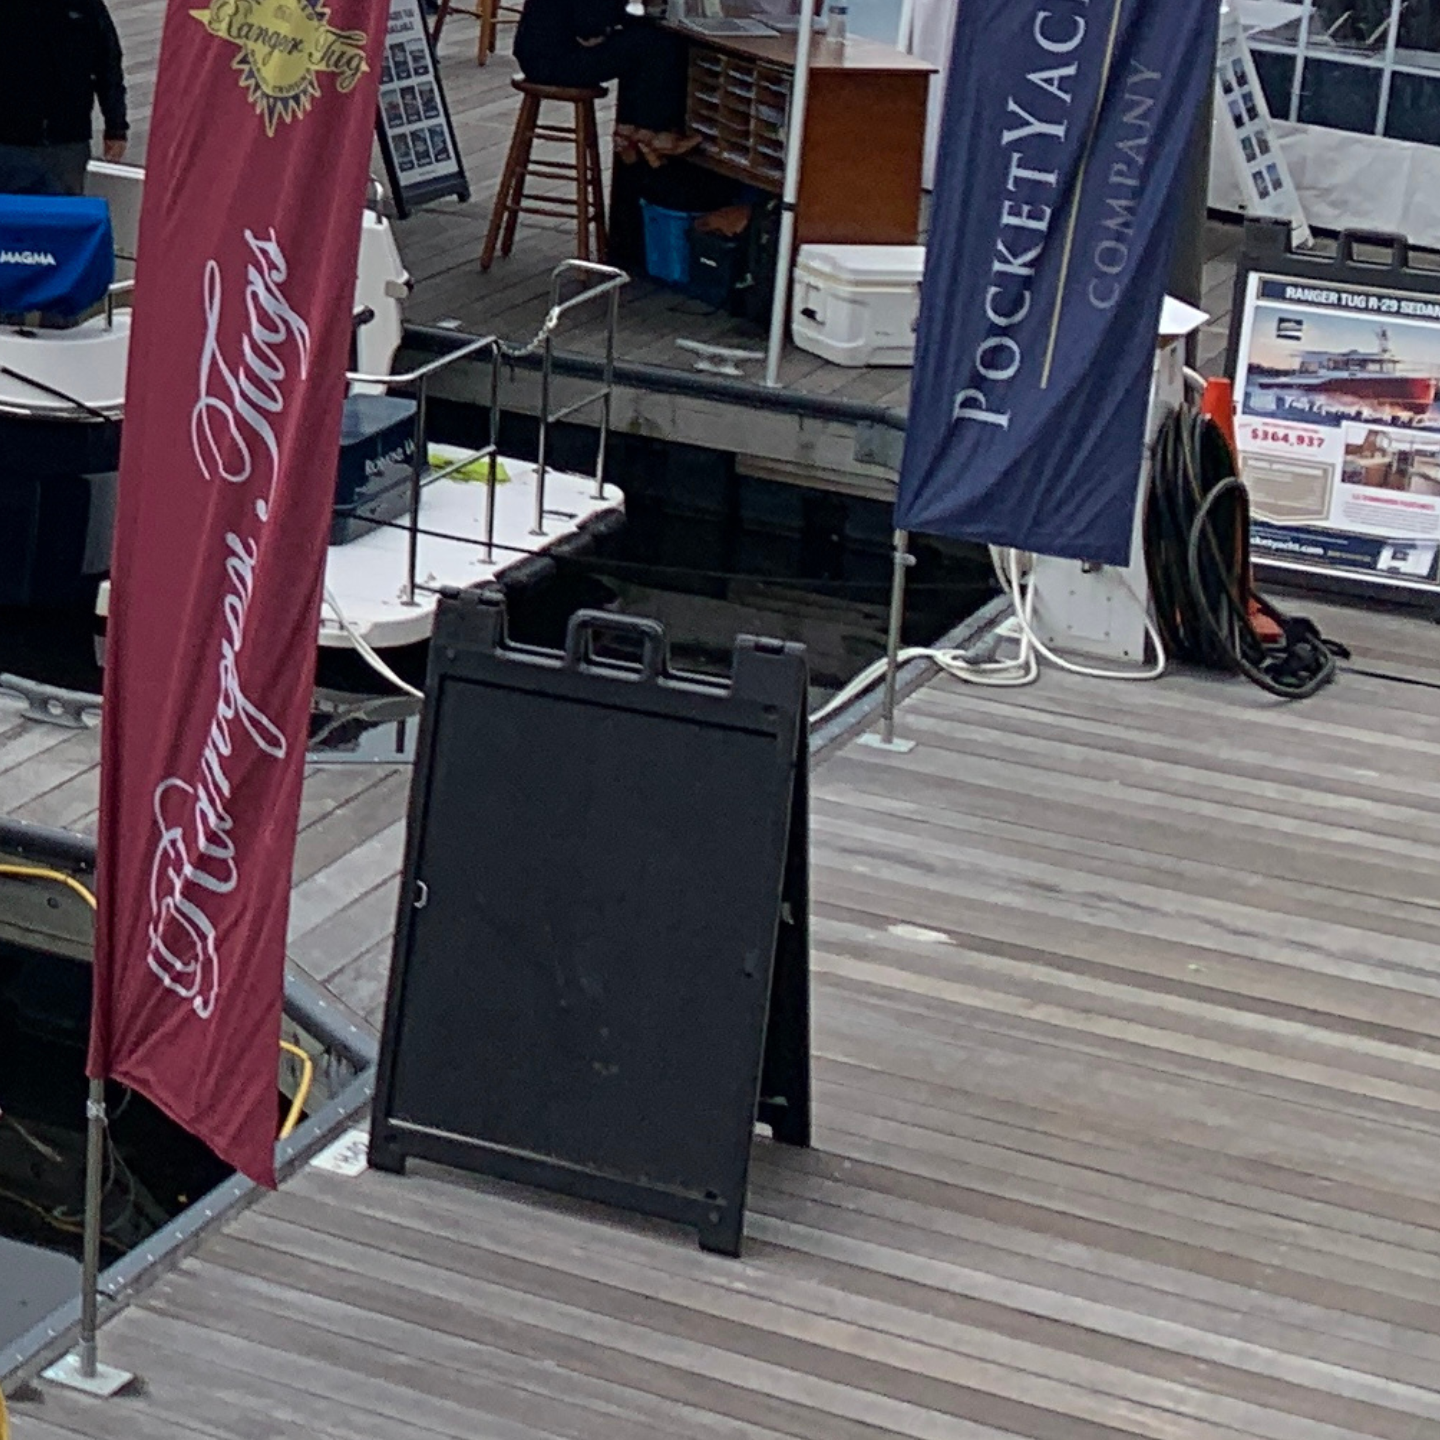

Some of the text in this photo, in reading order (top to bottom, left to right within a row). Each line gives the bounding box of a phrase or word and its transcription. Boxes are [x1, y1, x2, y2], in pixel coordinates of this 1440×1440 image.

[1087, 61, 1163, 310] COMPANY
[1285, 286, 1338, 305] RANGER
[1340, 293, 1367, 308] TUG
